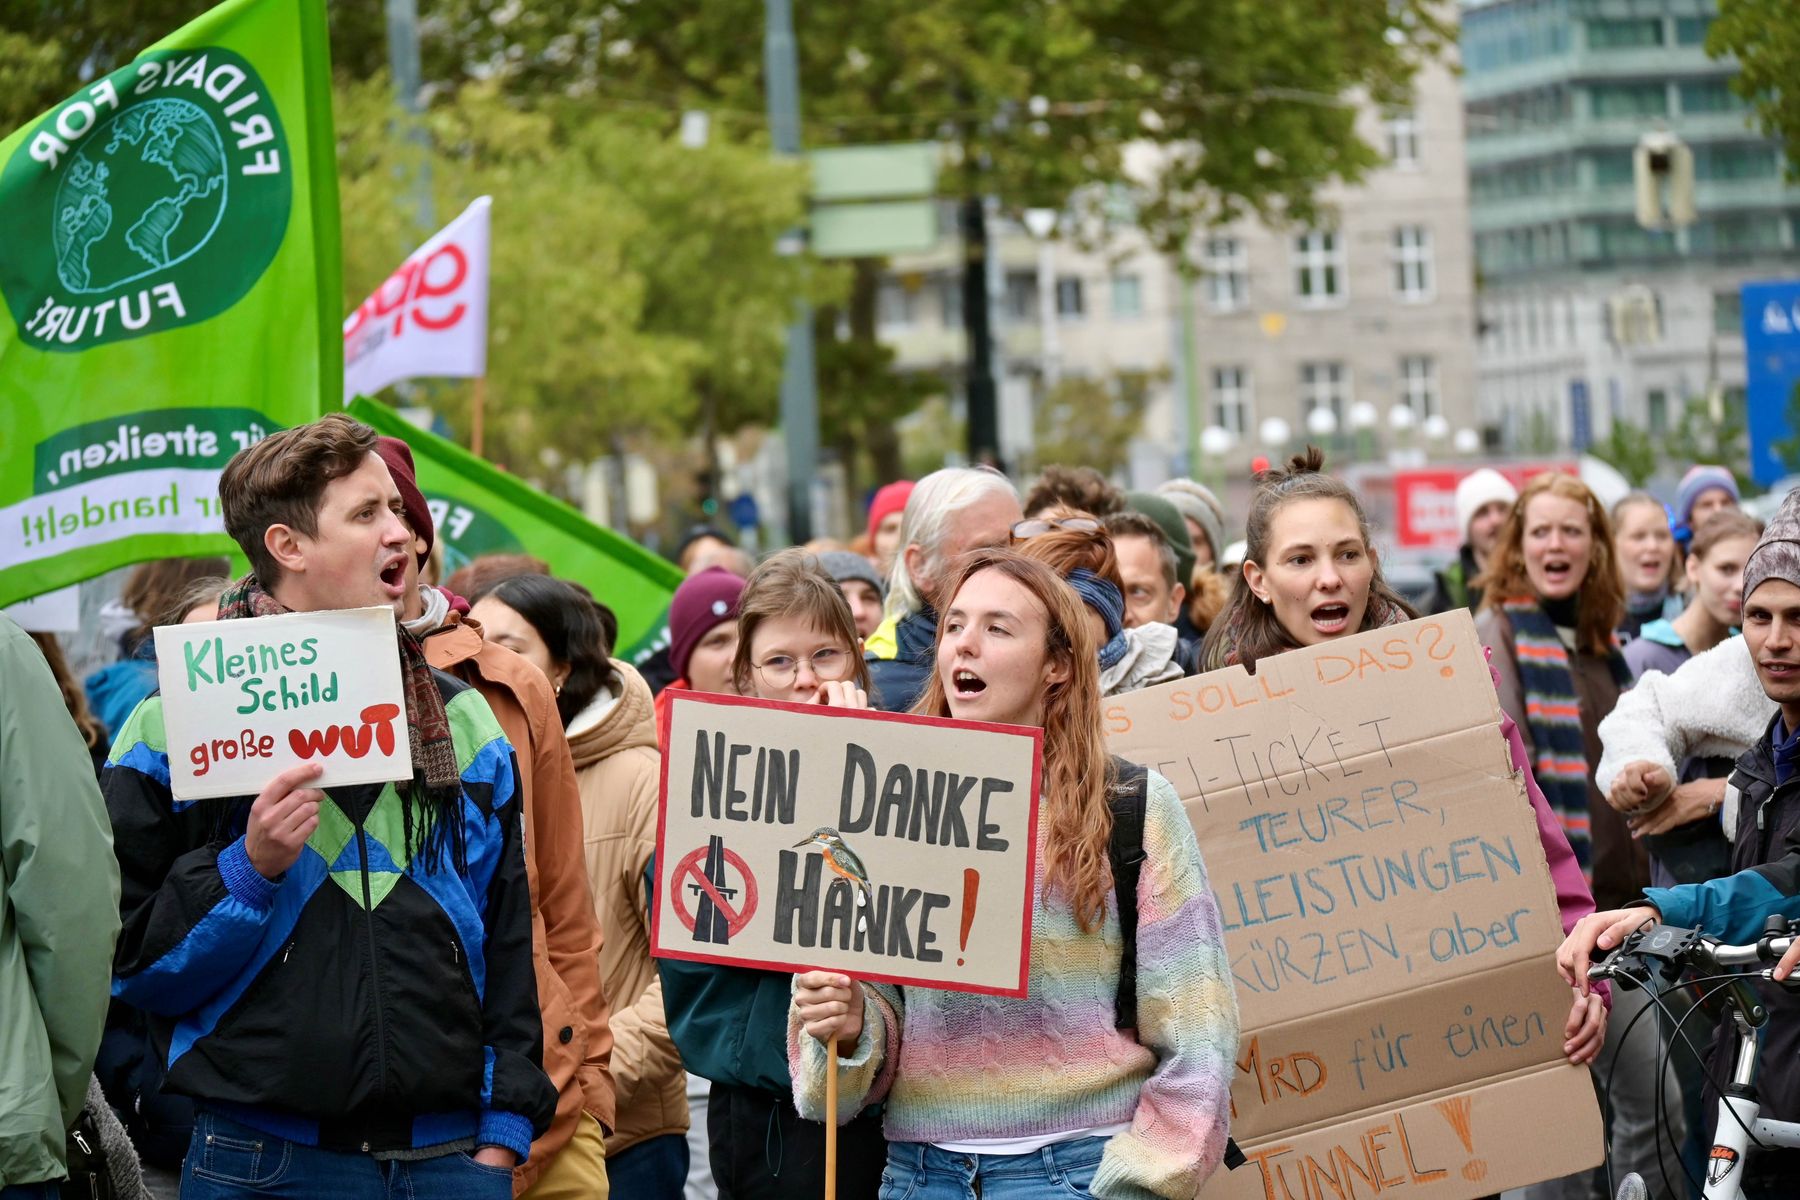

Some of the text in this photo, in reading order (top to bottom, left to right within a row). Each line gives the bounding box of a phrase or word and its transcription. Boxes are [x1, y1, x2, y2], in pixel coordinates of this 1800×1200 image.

[184, 636, 318, 692] Kleines
[236, 671, 339, 714] Schild
[1102, 623, 1456, 737] S SOLL DAS?
[190, 728, 275, 777] große
[690, 729, 1014, 852] NEIN DANKE
[1238, 780, 1446, 853] TEURER,
[1429, 908, 1531, 962] aber
[1349, 1023, 1413, 1090] für
[1444, 1004, 1546, 1058] einen
[1243, 1096, 1488, 1200] TUNNEL!
